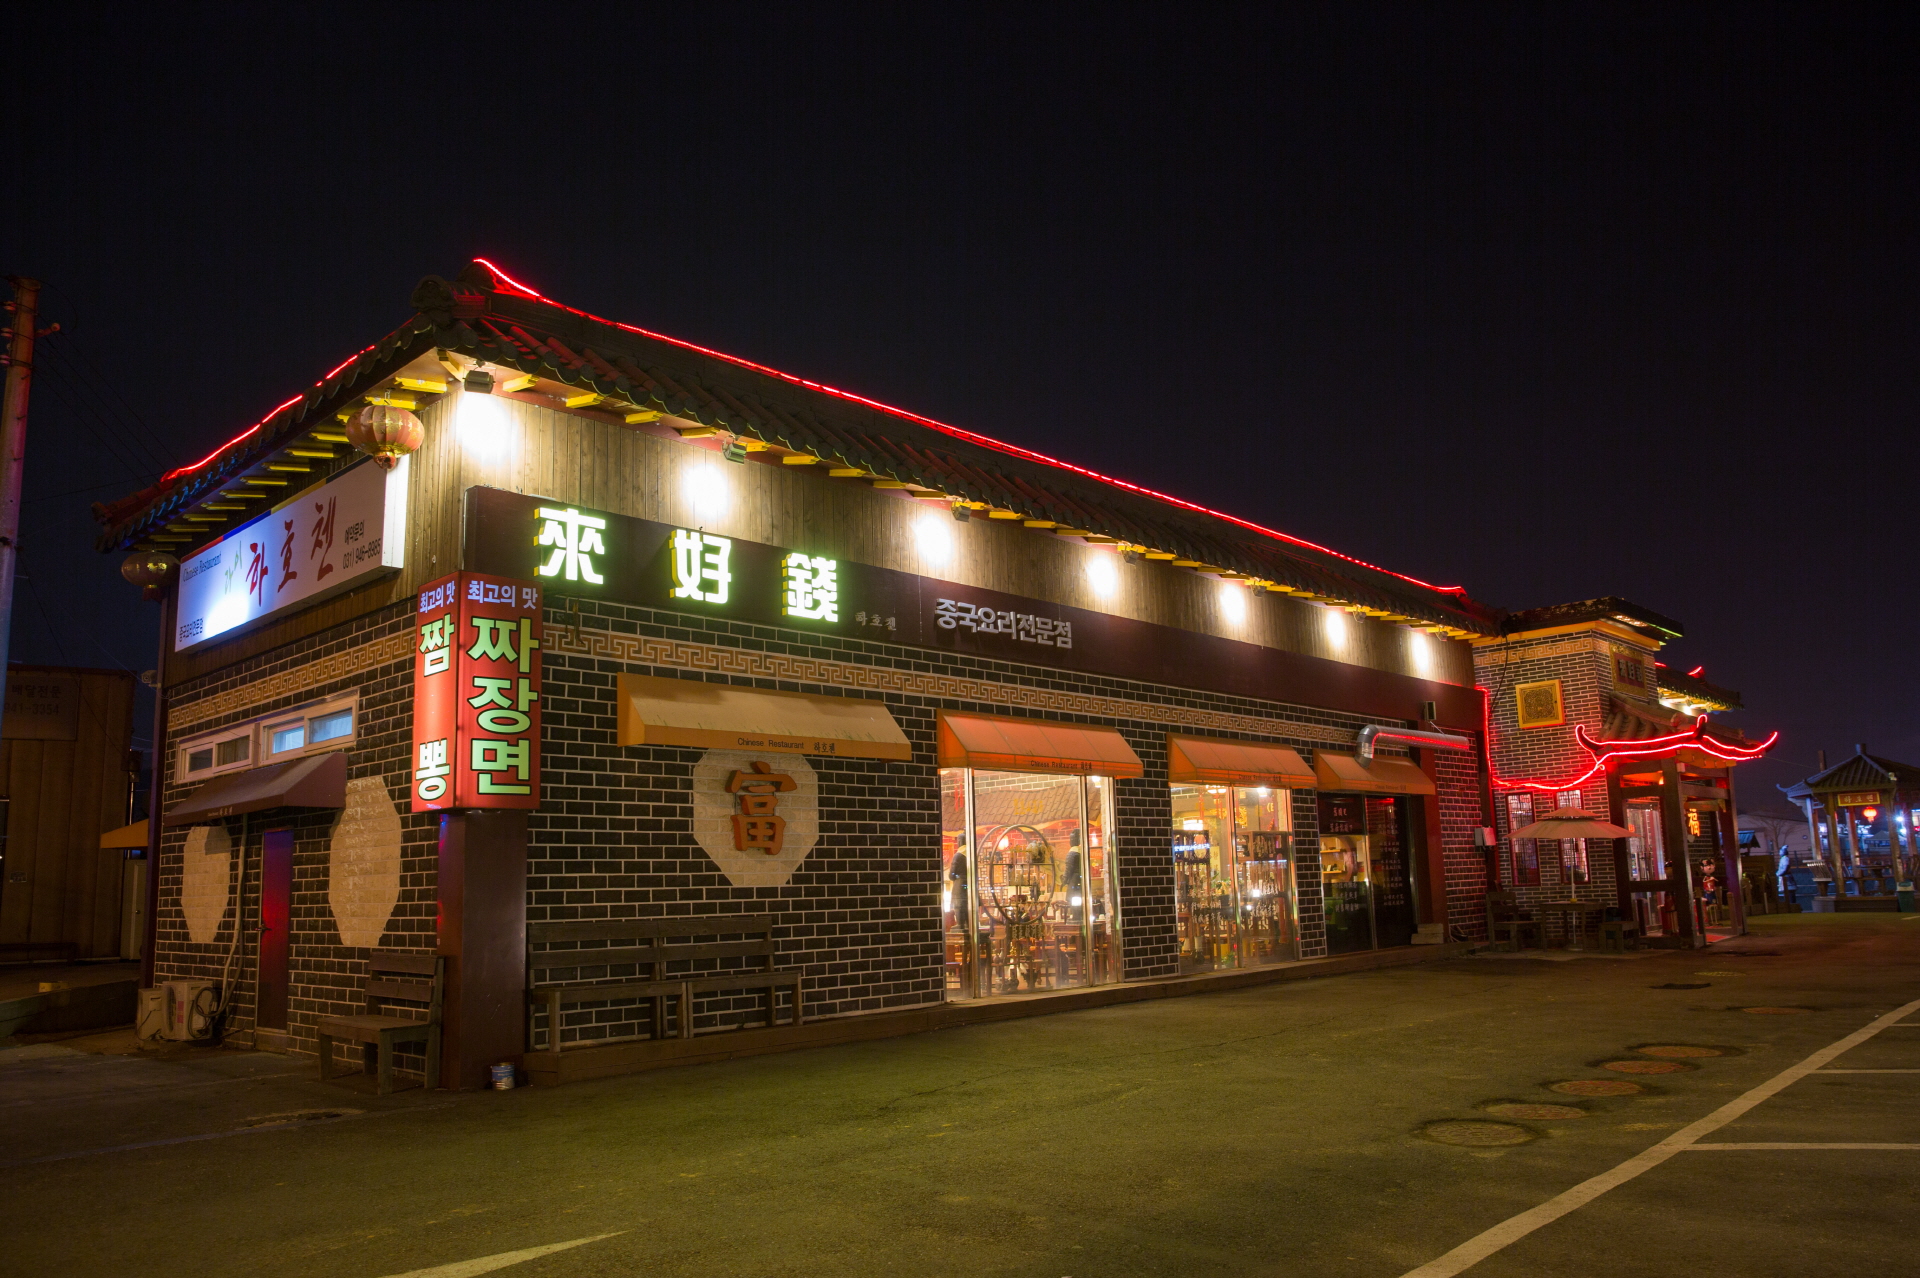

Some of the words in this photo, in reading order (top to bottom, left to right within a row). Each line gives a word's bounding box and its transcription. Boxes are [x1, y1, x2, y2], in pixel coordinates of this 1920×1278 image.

[344, 519, 365, 545] 예약문의
[182, 566, 199, 582] Chinese
[199, 550, 222, 575] Restaurant
[419, 585, 444, 613] 최고의
[446, 580, 455, 605] 맛
[467, 580, 516, 607] 최고의
[522, 587, 538, 609] 맛
[935, 598, 1072, 649] 중국요리전문점
[11, 684, 62, 698] 배달전문
[415, 613, 455, 801] 짬뽕
[466, 616, 540, 796] 짜장면
[737, 737, 764, 747] Chinese
[768, 739, 805, 749] Restaurant
[1030, 760, 1050, 768] Chinese
[1052, 761, 1078, 769] Restaurant
[725, 761, 797, 855] 富
